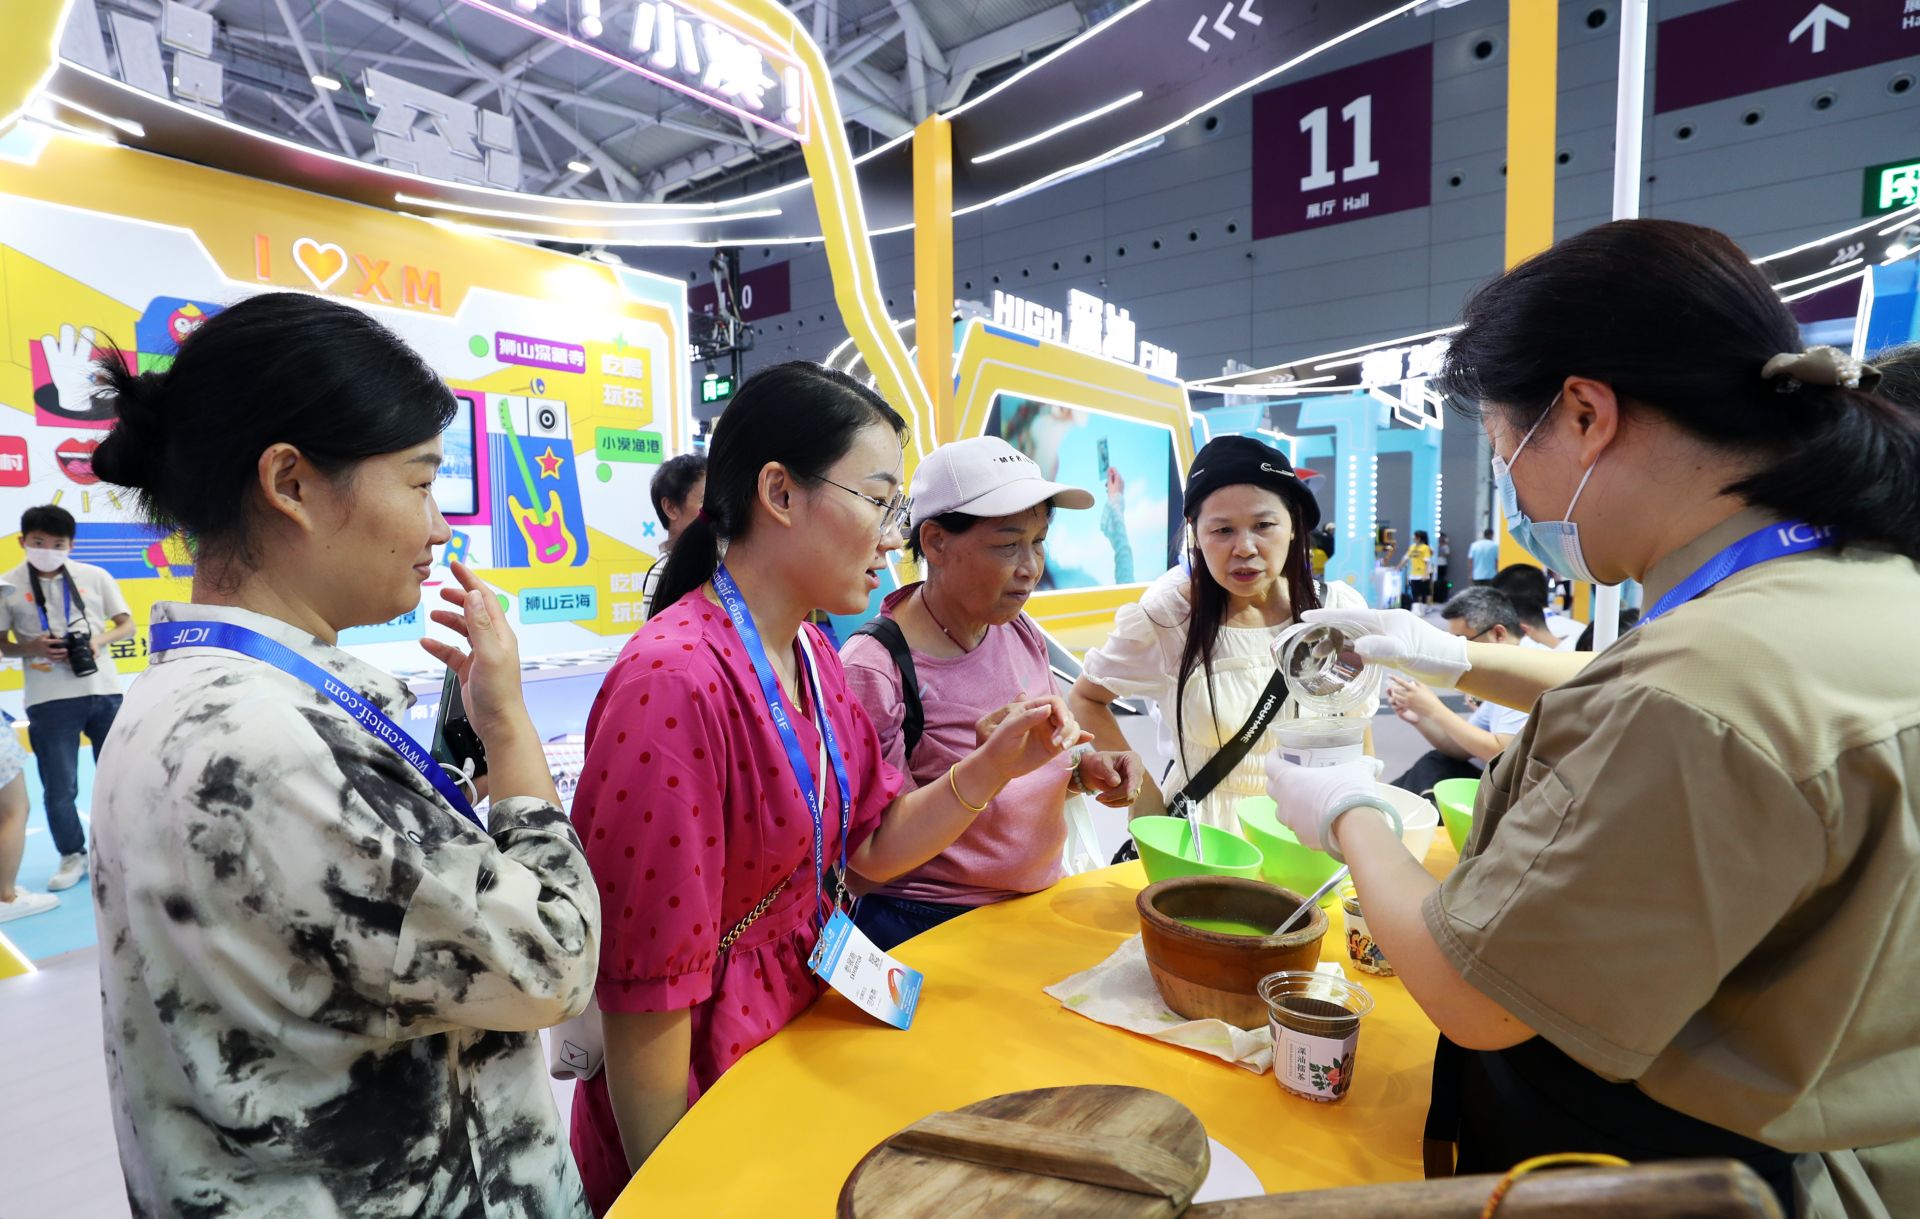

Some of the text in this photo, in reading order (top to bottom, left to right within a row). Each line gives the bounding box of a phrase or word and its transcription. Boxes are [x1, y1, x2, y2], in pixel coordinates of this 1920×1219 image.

[1299, 94, 1380, 192] 11
[1306, 192, 1370, 219] 展厅 Hall
[255, 233, 442, 311] I XM
[992, 289, 1063, 344] HIGH
[602, 383, 645, 410] 玩乐
[602, 435, 661, 455] 小漠渔港
[524, 593, 592, 612] 狮山云海
[108, 636, 149, 660] 金
[170, 627, 211, 645] ICIF
[323, 679, 430, 773] www.cnicif.com
[769, 700, 790, 731] ICIF
[842, 800, 850, 829] ICIF
